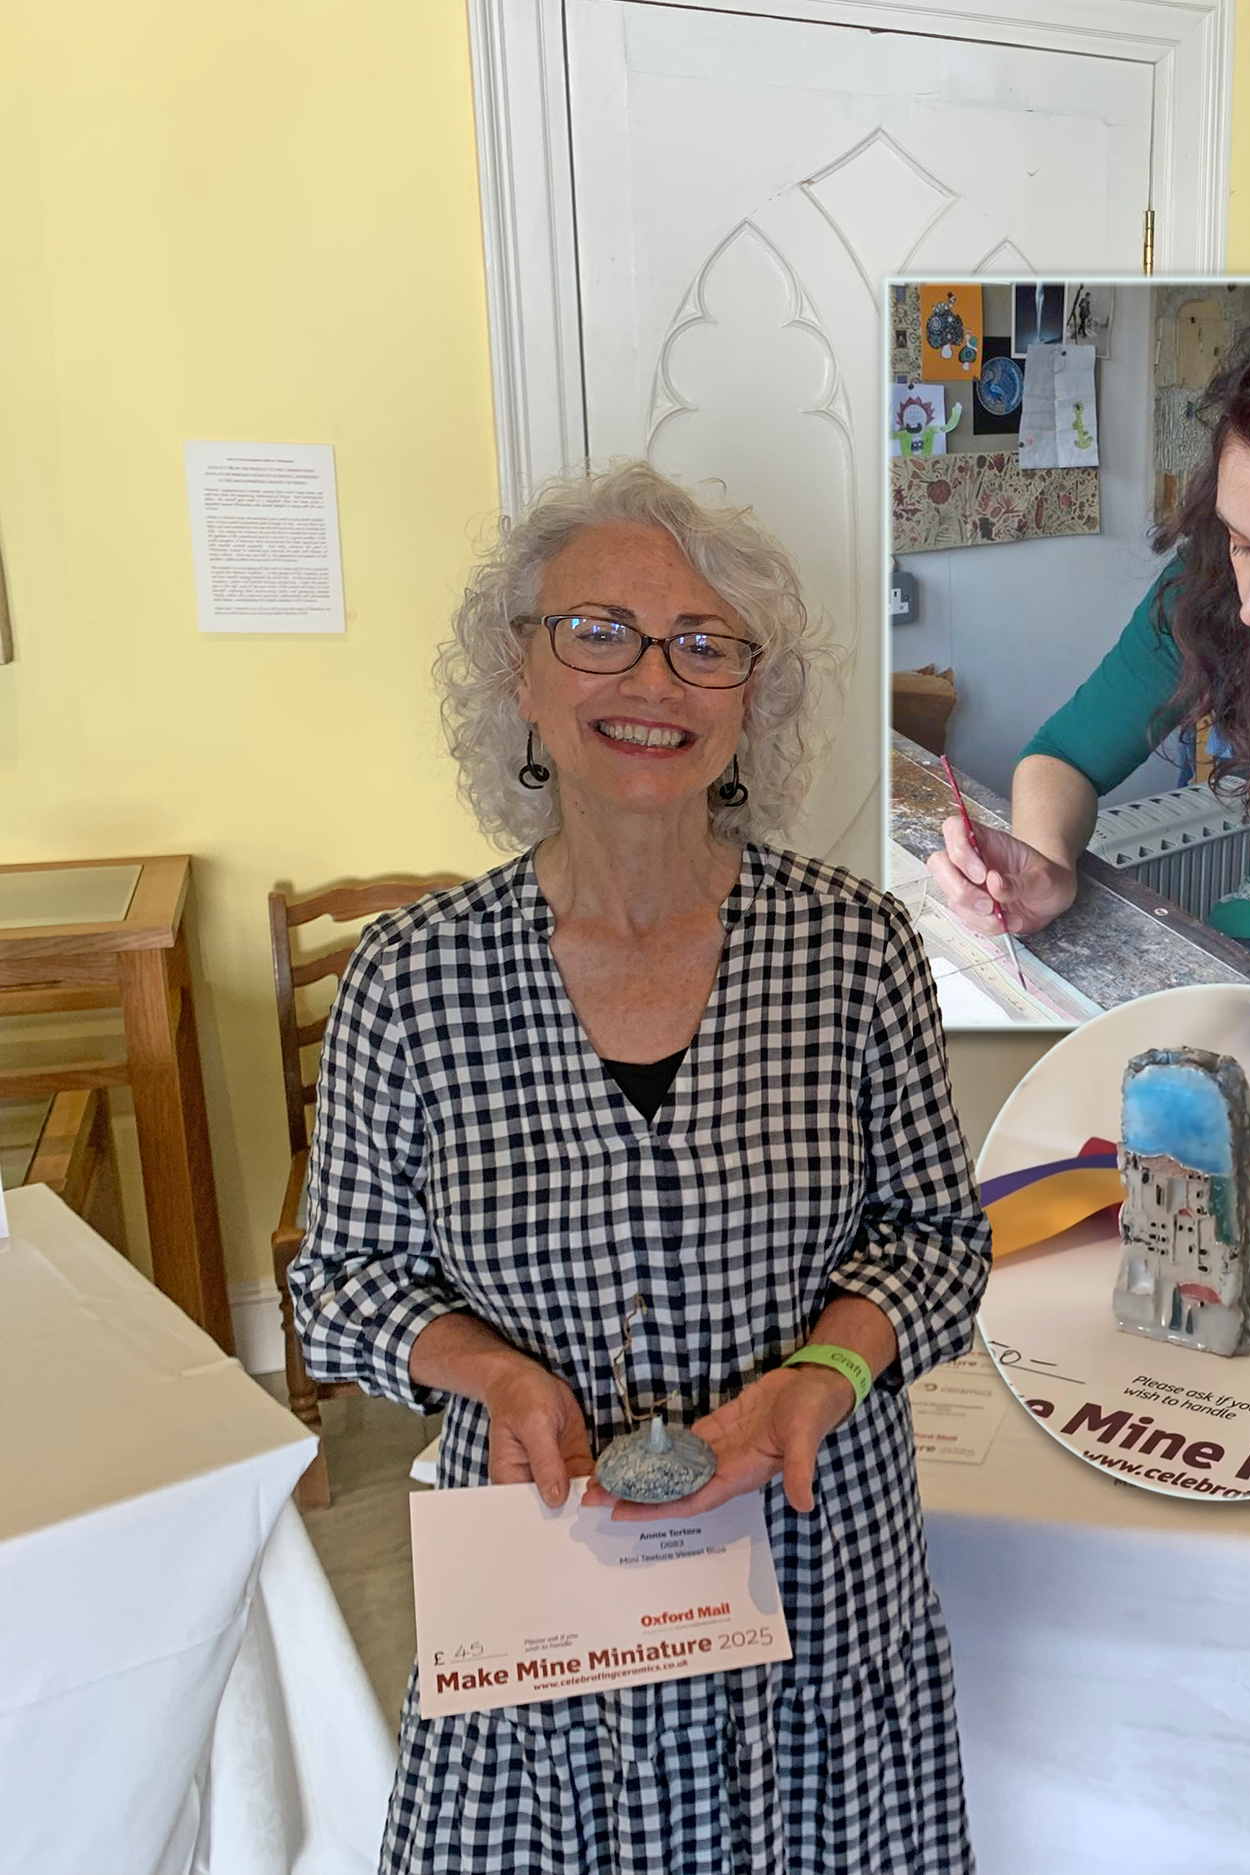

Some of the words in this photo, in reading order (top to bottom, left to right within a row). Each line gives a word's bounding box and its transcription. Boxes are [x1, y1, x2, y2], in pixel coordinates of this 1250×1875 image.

[831, 1352, 862, 1377] Craft
[1124, 1386, 1160, 1402] wish
[1162, 1395, 1179, 1406] to
[1180, 1399, 1237, 1420] handle
[1132, 1375, 1185, 1395] Please
[1186, 1388, 1214, 1402] ask
[1215, 1395, 1234, 1407] if
[1060, 1402, 1226, 1470] Mine
[640, 1531, 667, 1540] Annie
[619, 1556, 640, 1565] Mini
[641, 1607, 694, 1628] Oxford
[697, 1602, 731, 1620] Mail
[434, 1651, 445, 1666] £
[436, 1667, 509, 1694] Make
[516, 1658, 582, 1682] Mine
[588, 1637, 712, 1670] Miniature
[718, 1626, 773, 1650] 2025
[533, 1659, 689, 1692] www.celebratingceramics.co.uk
